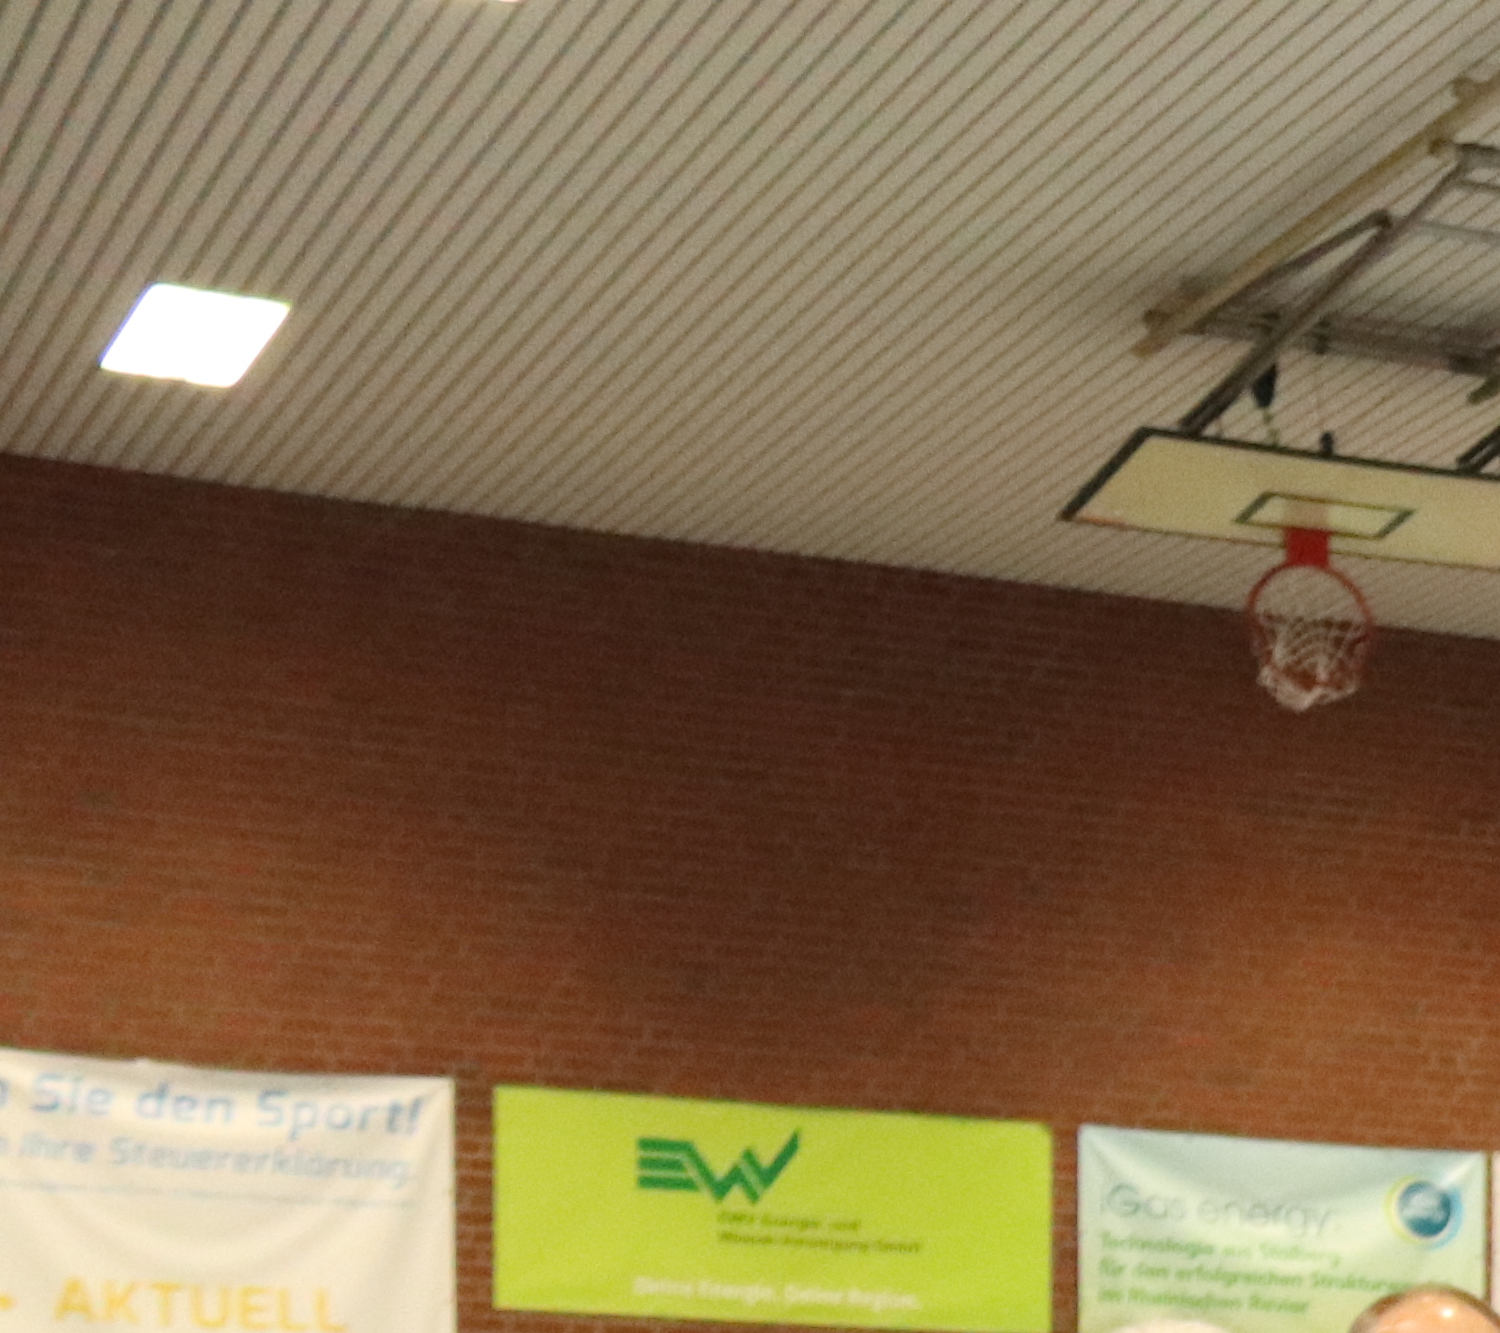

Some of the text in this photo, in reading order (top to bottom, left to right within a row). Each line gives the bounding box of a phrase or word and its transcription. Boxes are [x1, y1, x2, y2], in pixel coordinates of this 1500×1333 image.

[31, 1072, 114, 1118] Sie
[136, 1081, 236, 1127] den
[256, 1088, 425, 1141] Sport!
